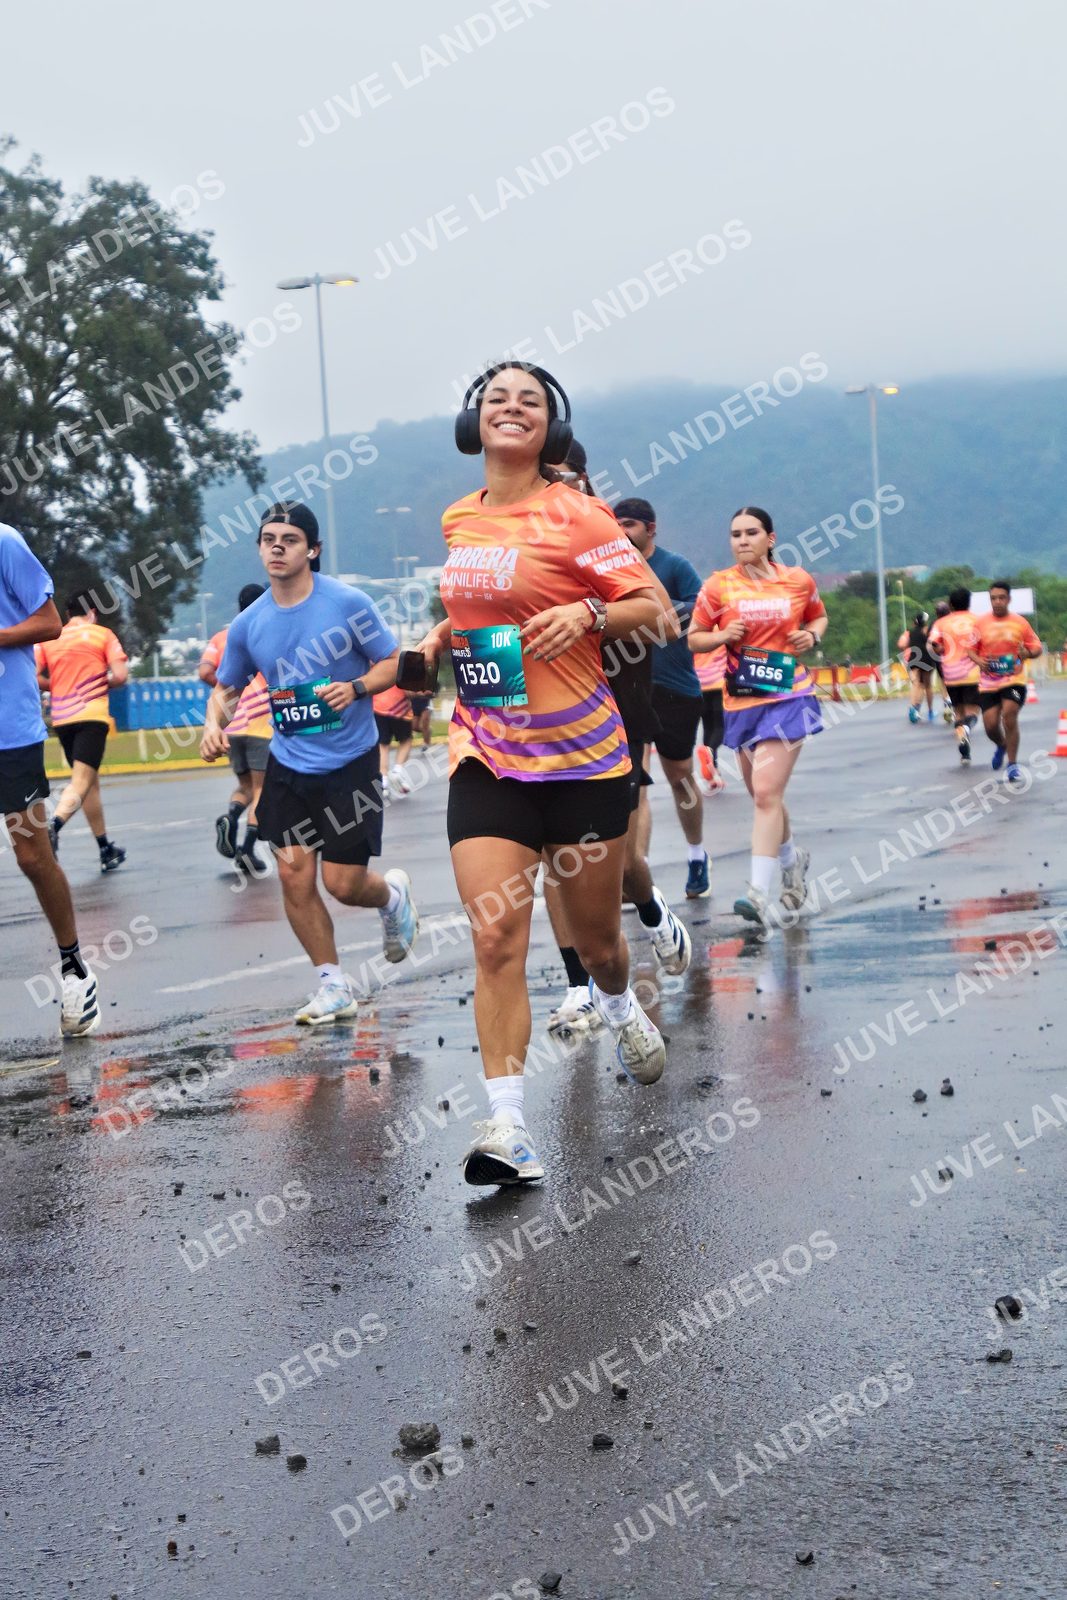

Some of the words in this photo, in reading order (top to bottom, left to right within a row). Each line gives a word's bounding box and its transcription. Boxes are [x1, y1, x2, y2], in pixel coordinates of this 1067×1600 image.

[491, 631, 511, 648] 10K
[460, 661, 500, 685] 1520
[749, 664, 783, 682] 1656
[312, 683, 327, 696] 10
[282, 703, 321, 722] 1676
